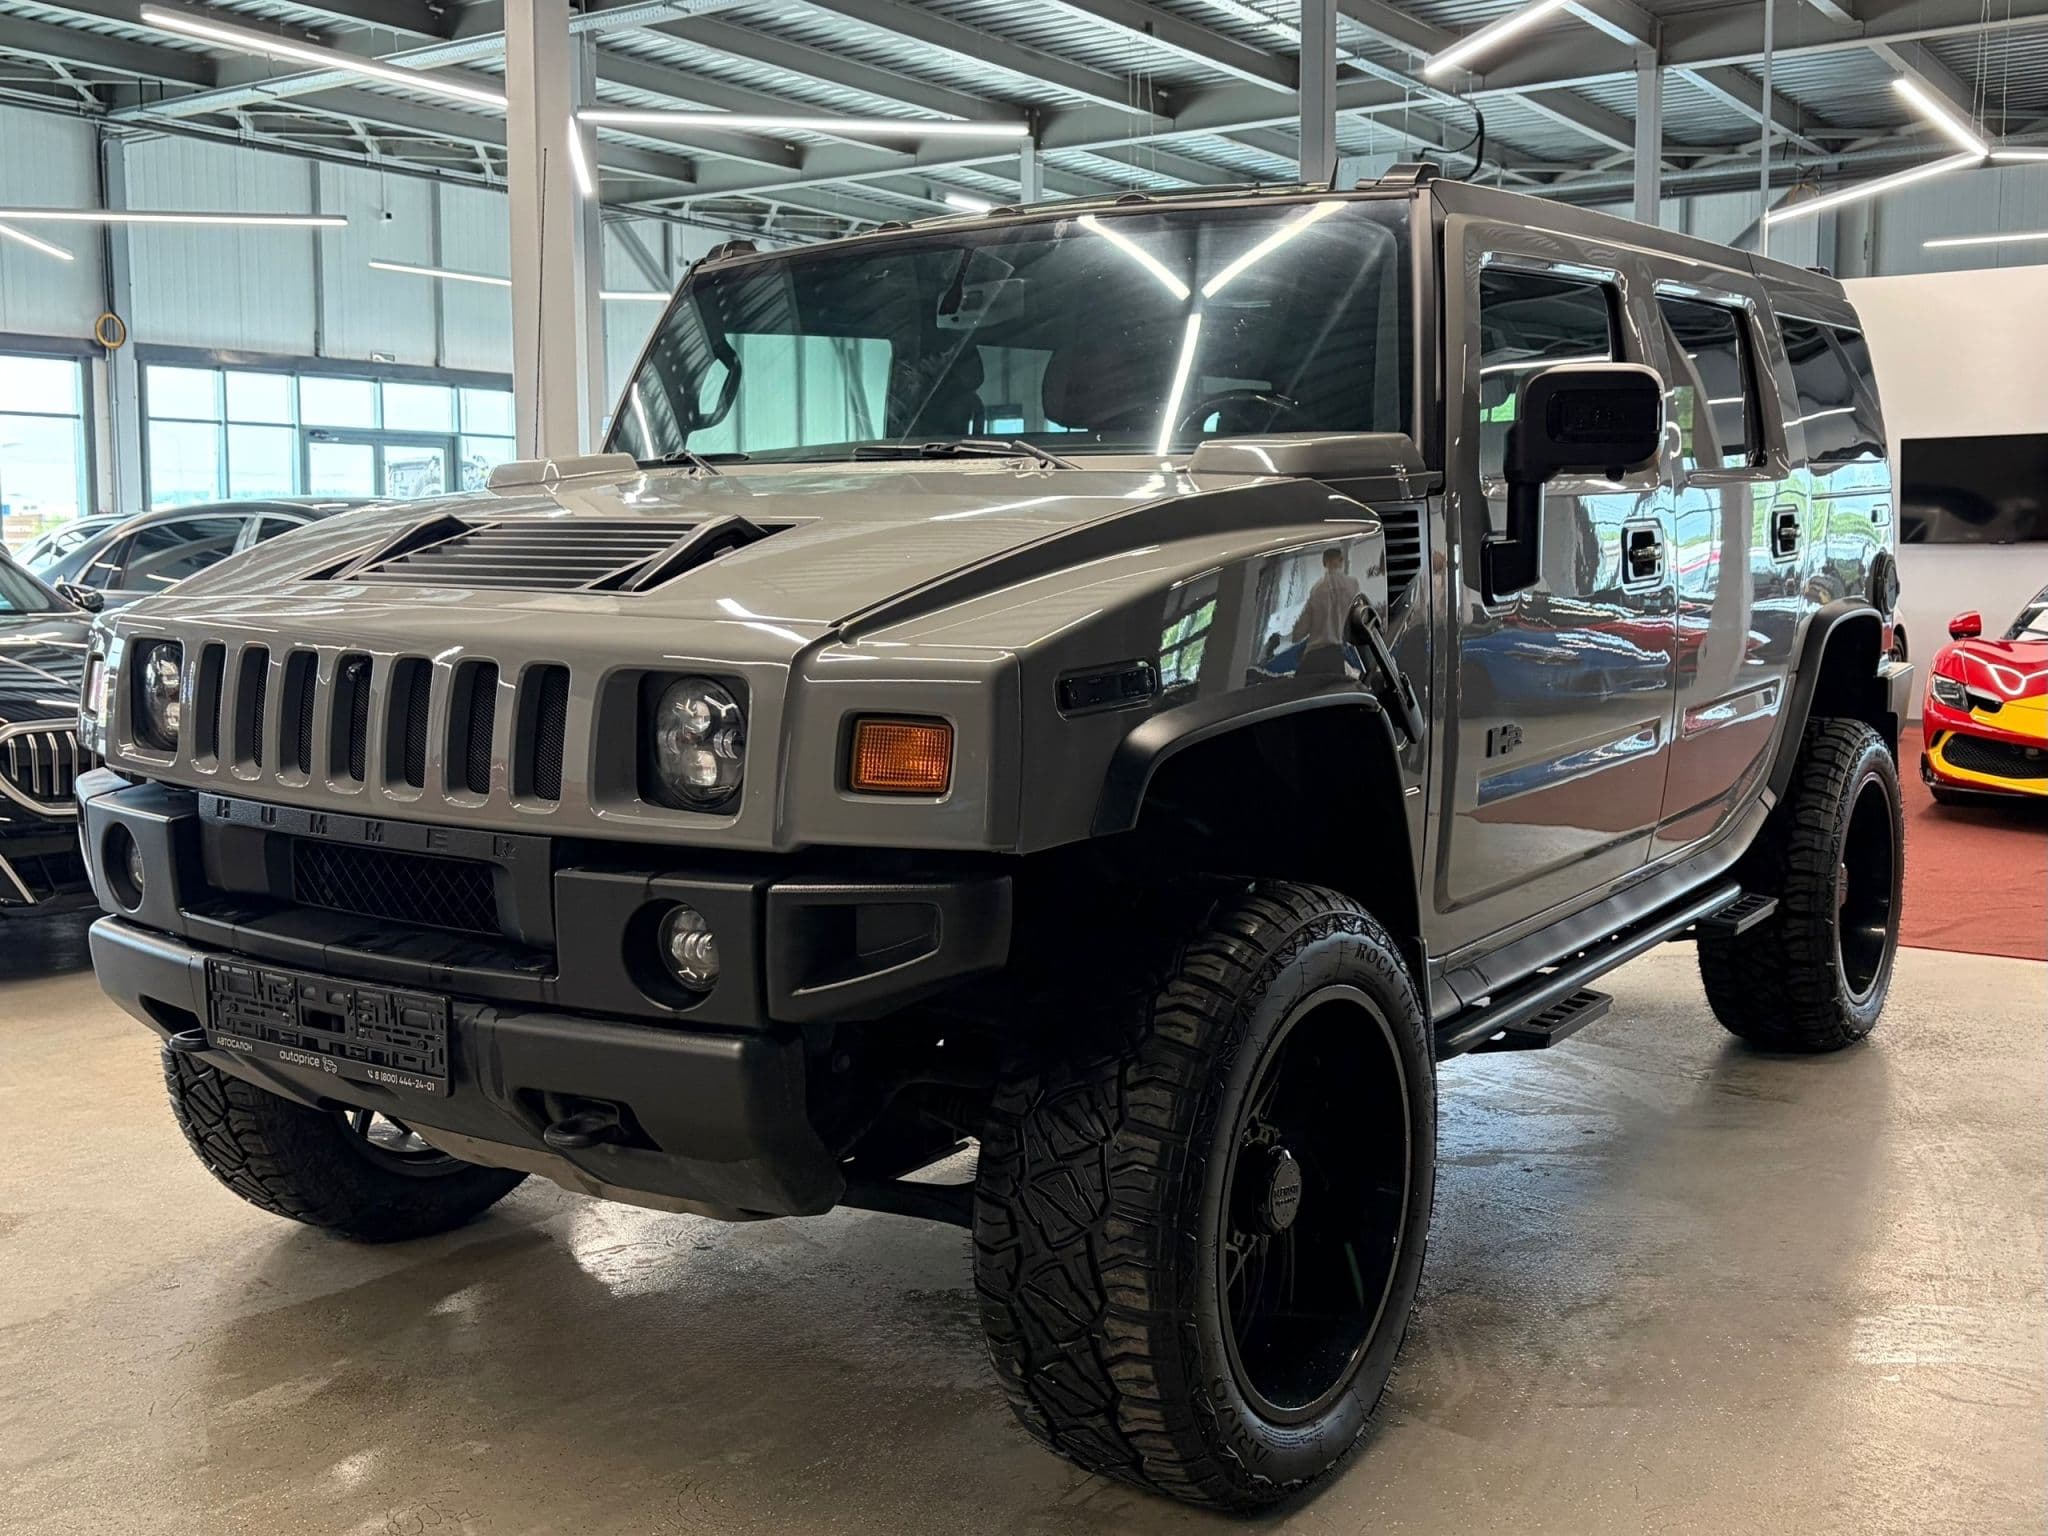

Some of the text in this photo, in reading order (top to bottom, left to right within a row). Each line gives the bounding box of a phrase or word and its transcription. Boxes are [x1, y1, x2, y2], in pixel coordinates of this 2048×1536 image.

[1485, 724, 1523, 759] H2
[216, 797, 517, 859] HUMMER
[1355, 942, 1398, 985] ROCK
[216, 1036, 253, 1053] АВТОСАЛОН
[279, 1050, 320, 1068] autoprice
[374, 1070, 435, 1092] 8 (800) 444-24-01
